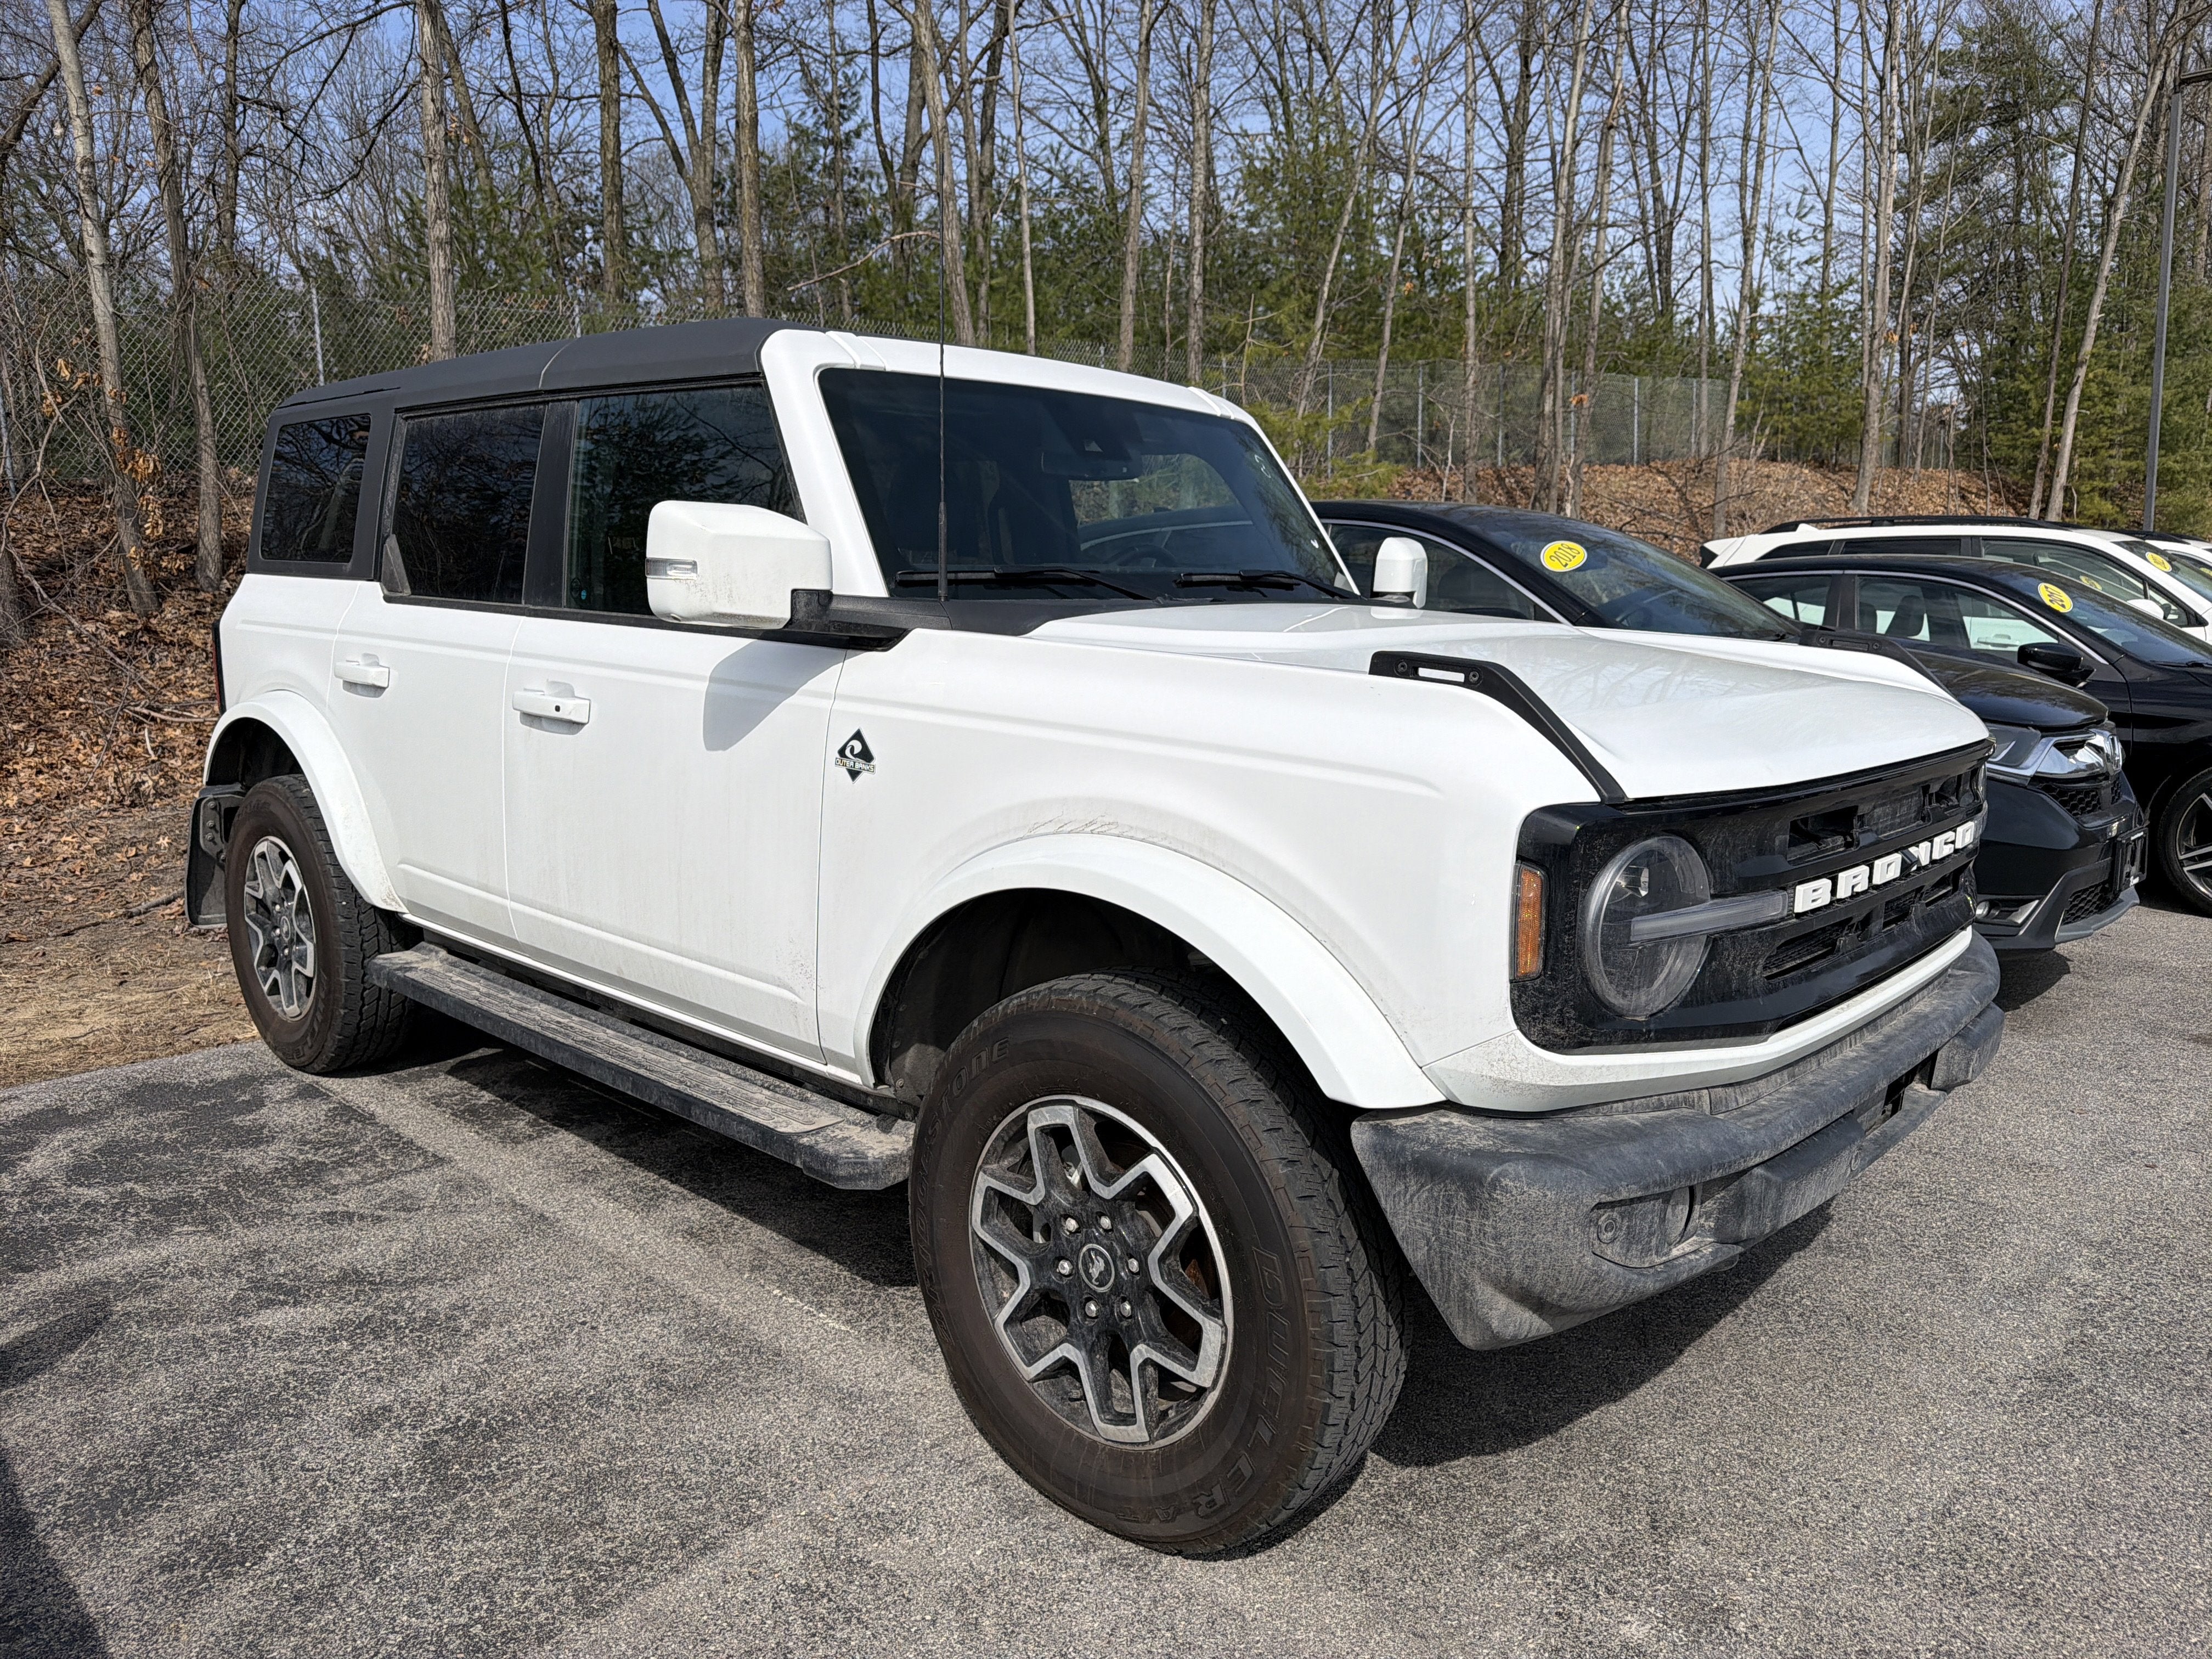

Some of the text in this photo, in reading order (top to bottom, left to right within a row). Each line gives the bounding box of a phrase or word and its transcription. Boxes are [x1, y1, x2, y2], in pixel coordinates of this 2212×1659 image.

[1549, 543, 1581, 568] 2018
[836, 758, 874, 772] OUTER BANKS
[1794, 821, 1974, 913] BRONCO
